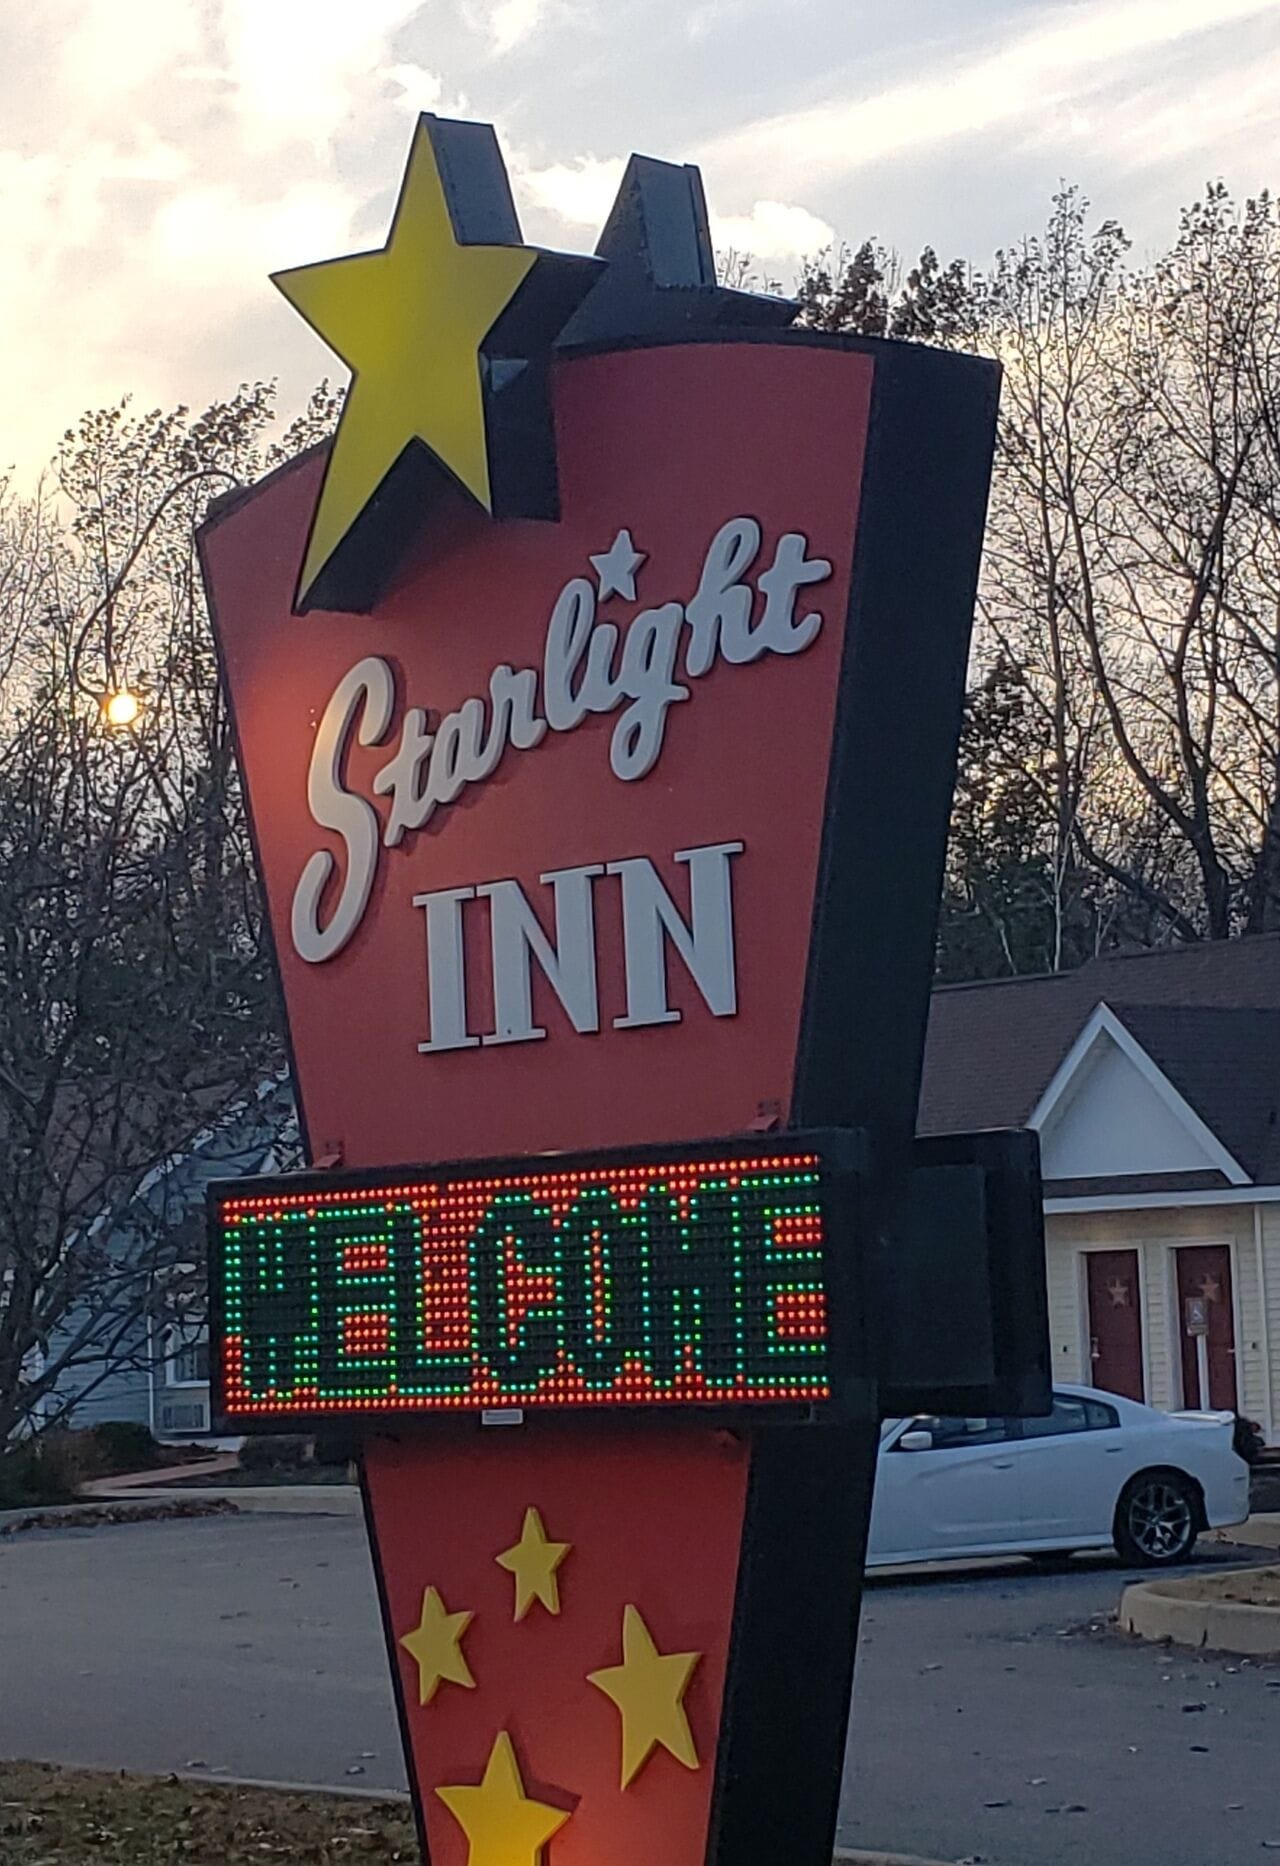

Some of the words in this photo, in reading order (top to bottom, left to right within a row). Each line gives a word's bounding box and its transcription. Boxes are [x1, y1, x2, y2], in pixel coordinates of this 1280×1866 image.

[291, 517, 832, 963] Starlight
[412, 841, 744, 1055] INN
[224, 1173, 829, 1399] WELCOME
